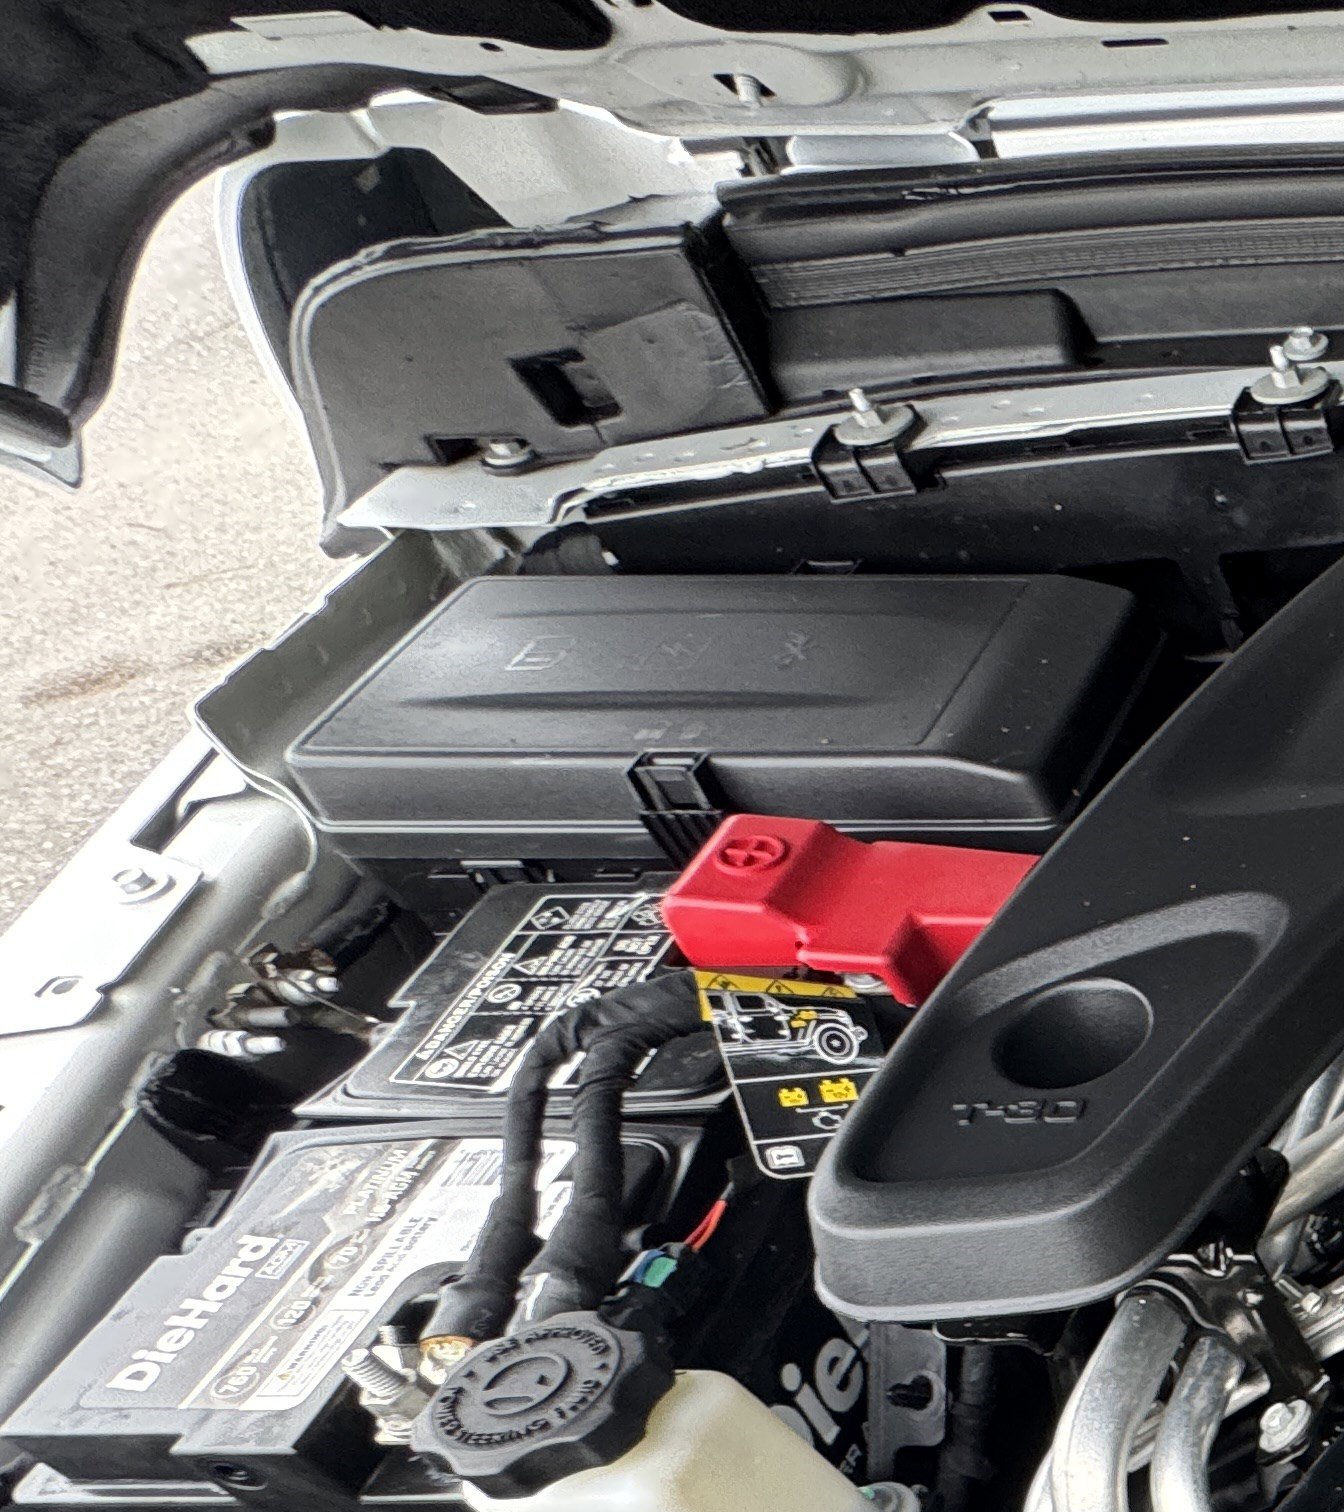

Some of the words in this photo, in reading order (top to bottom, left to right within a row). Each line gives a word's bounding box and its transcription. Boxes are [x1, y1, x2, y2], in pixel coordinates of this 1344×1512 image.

[332, 1245, 359, 1267] 70
[106, 1235, 281, 1392] DieHard
[278, 1298, 306, 1327] 120
[218, 1365, 257, 1393] 760
